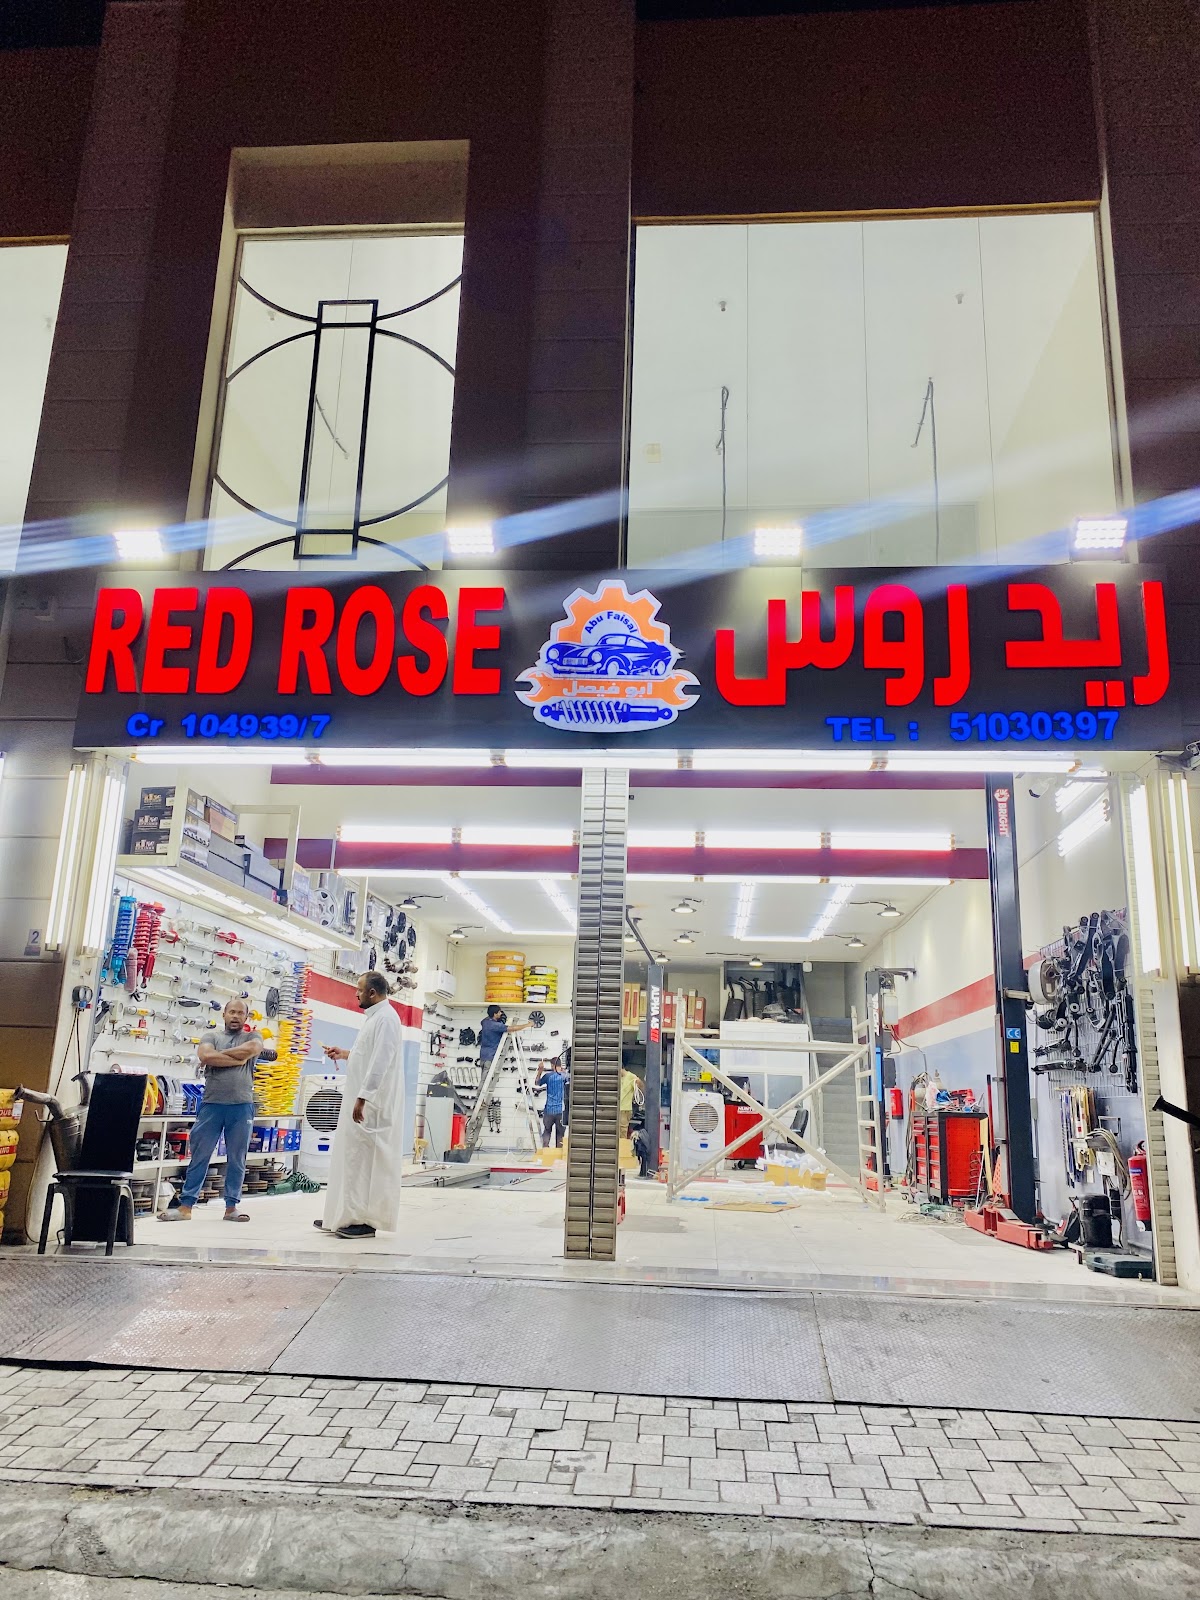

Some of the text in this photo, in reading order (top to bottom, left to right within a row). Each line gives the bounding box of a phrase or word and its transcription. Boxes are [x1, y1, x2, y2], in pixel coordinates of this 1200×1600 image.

[585, 611, 638, 634] Abu Faisal
[86, 583, 506, 696] RED ROSE
[715, 580, 1171, 707] ريد روس
[562, 680, 653, 698] ابو فيصل
[126, 712, 331, 740] Cr 104939/7
[825, 716, 896, 742] TEL
[949, 711, 1120, 742] 51030397
[998, 803, 1009, 838] BRIGHT
[31, 930, 40, 944] 2
[650, 985, 660, 1016] ALPHA
